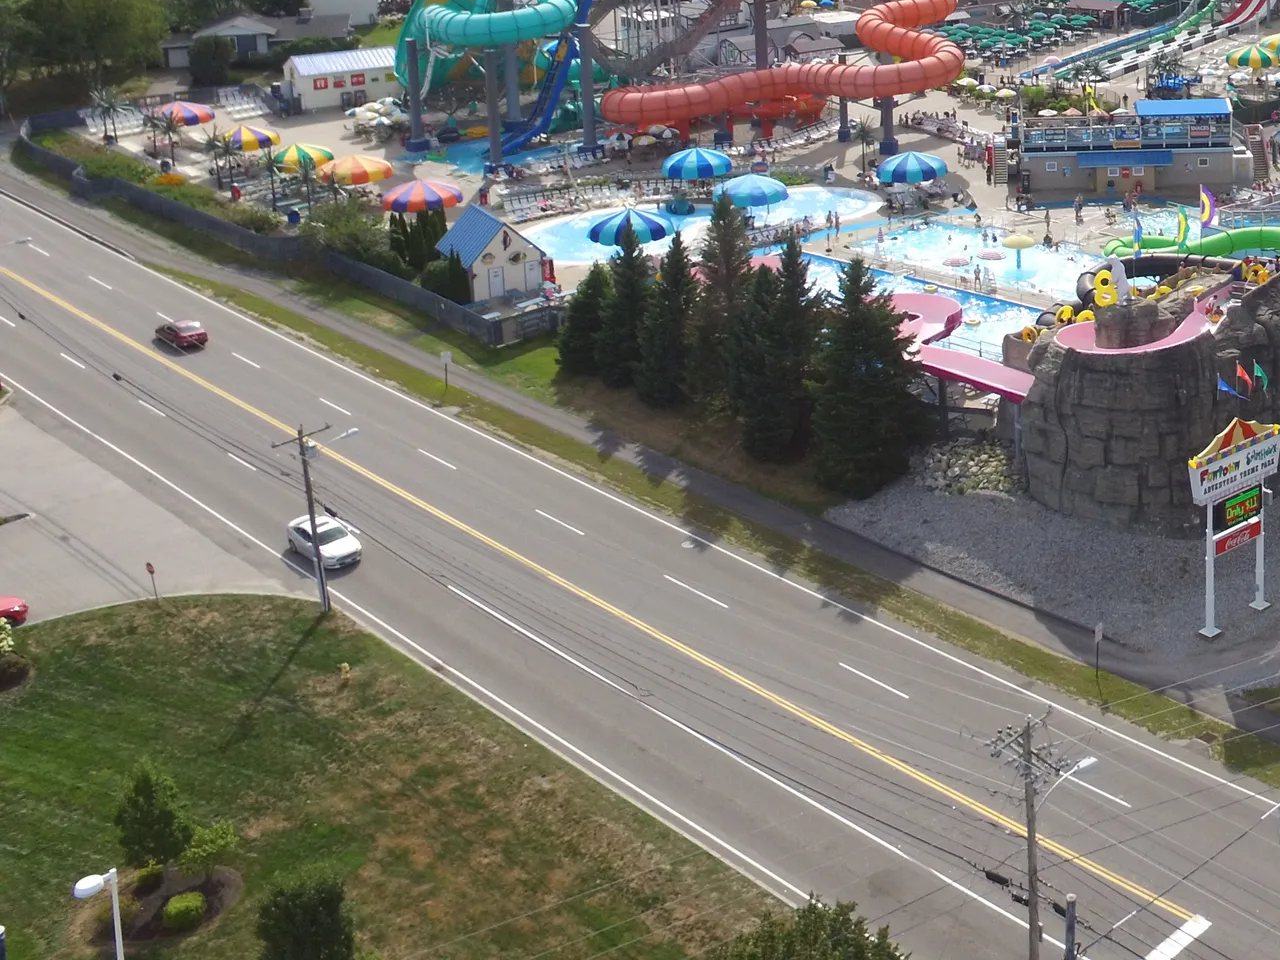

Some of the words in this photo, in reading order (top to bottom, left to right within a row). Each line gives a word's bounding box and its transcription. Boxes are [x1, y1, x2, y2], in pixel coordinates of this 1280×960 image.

[1203, 475, 1237, 495] ADVENTURE
[1240, 464, 1259, 478] THEME
[1260, 458, 1275, 470] PARK
[1226, 504, 1244, 519] Only
